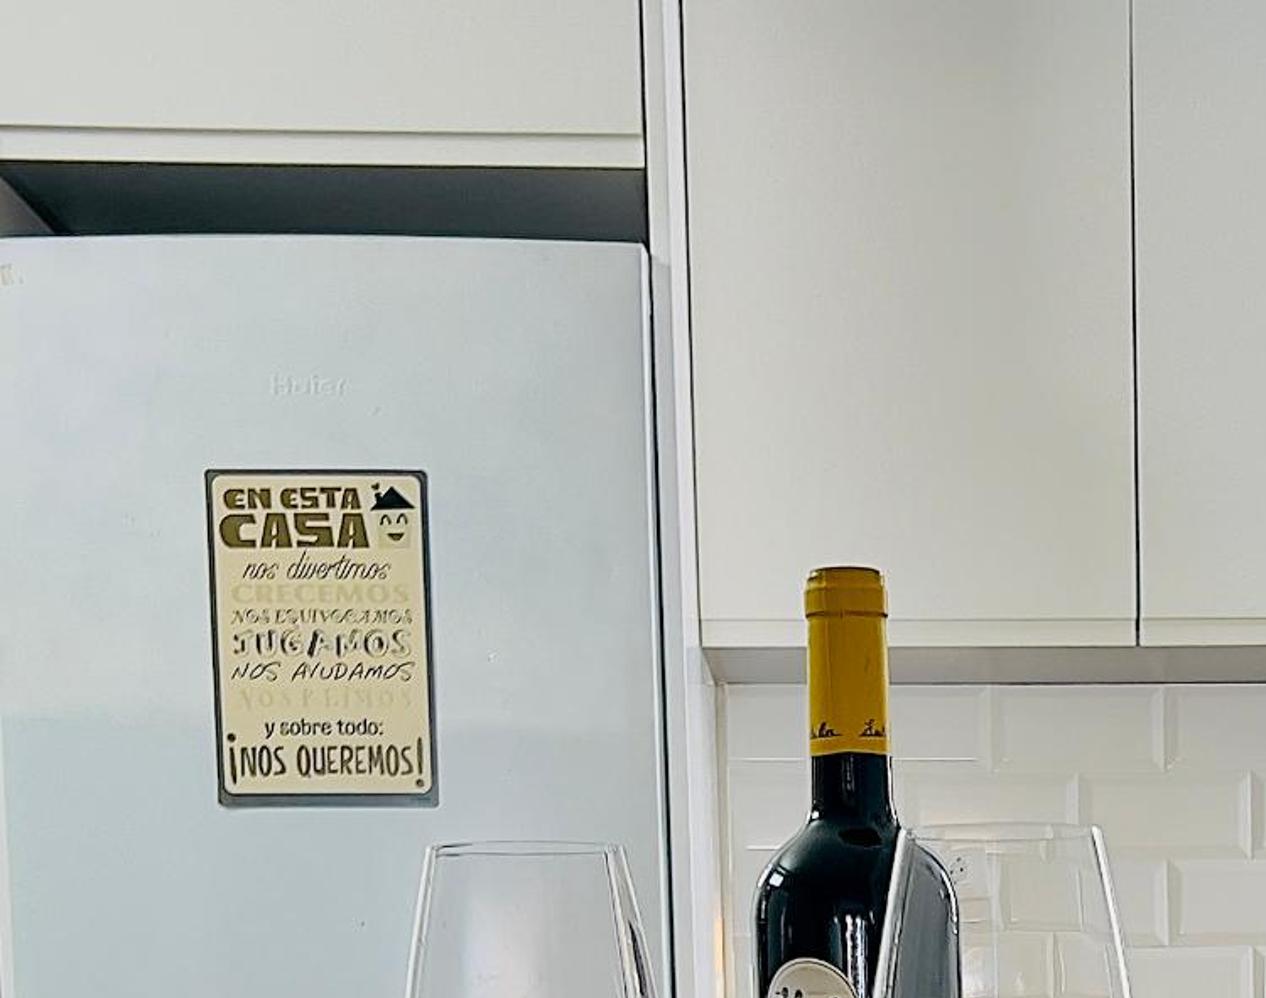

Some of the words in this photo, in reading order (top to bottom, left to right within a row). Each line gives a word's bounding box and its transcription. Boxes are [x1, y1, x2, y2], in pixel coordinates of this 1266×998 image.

[223, 487, 272, 510] EN
[279, 486, 362, 510] ESTA
[219, 512, 370, 549] CASA
[242, 561, 279, 580] nos
[286, 550, 391, 580] divertimos
[230, 583, 411, 604] CRECEMOS
[232, 627, 413, 659] JUGAMOS
[231, 661, 282, 682] NOS
[291, 660, 416, 682] AYUDAMOS
[264, 721, 275, 739] y
[279, 717, 332, 736] sobre
[336, 718, 385, 736] todo:
